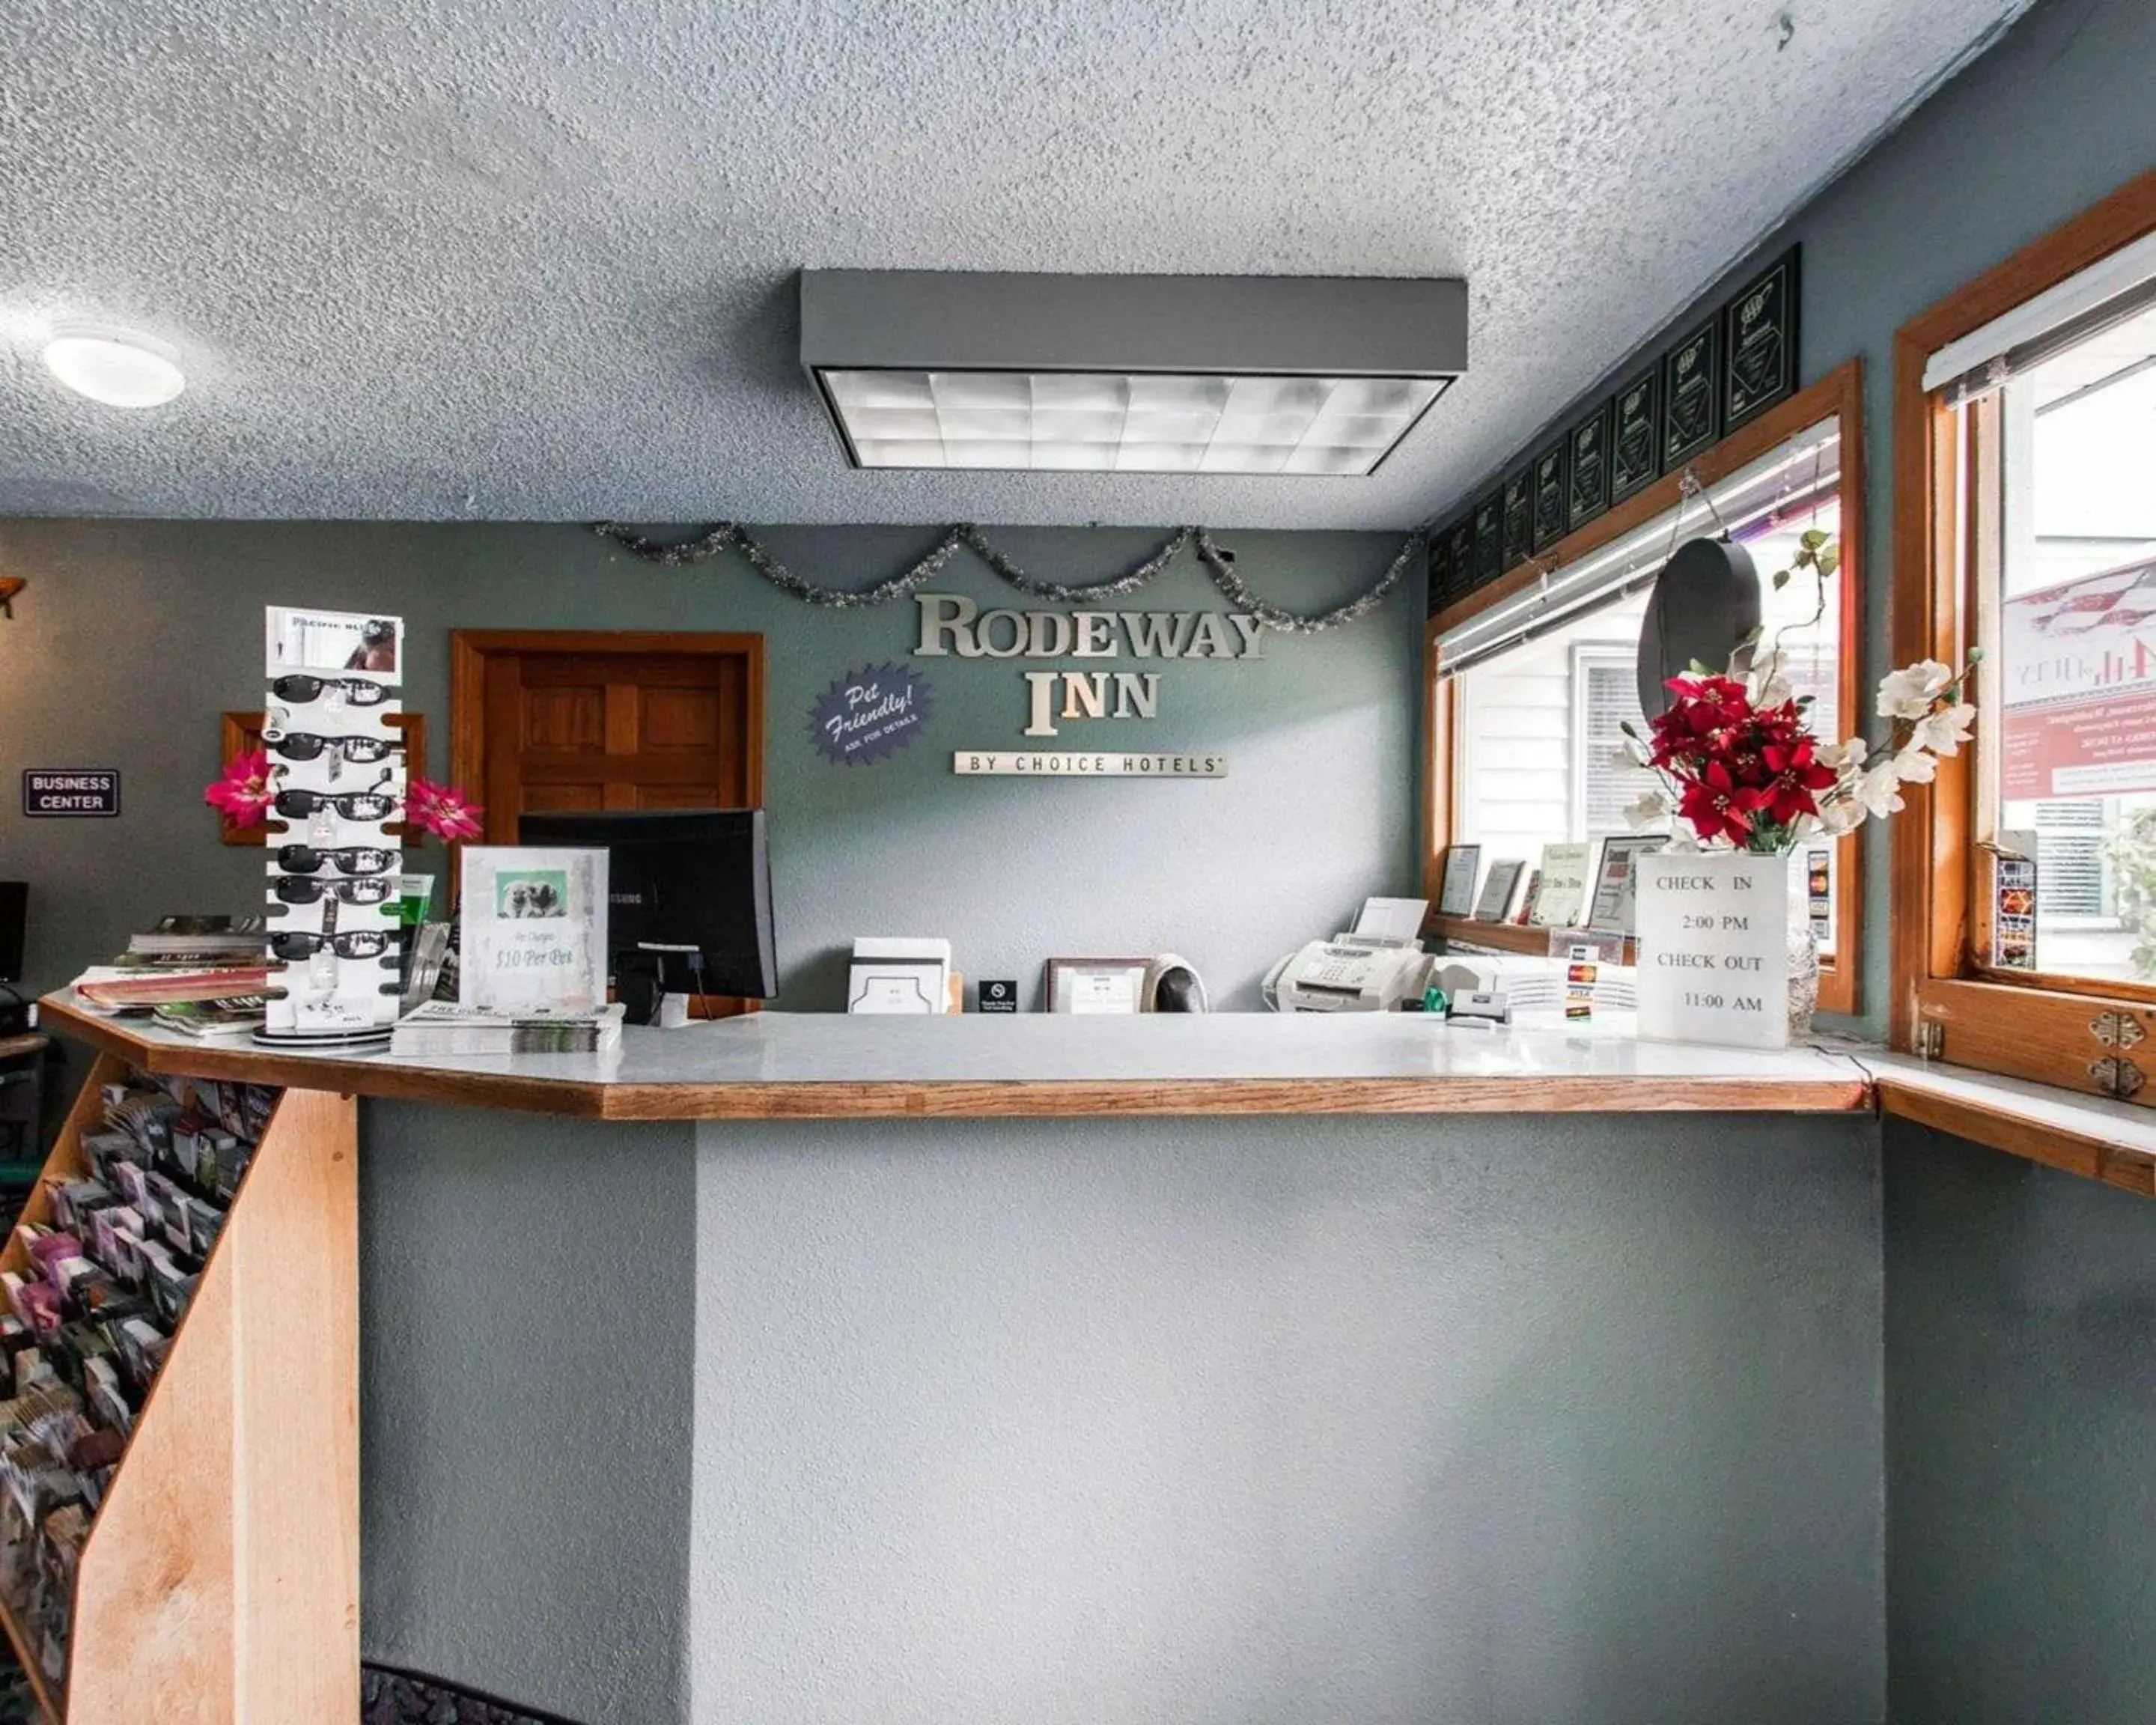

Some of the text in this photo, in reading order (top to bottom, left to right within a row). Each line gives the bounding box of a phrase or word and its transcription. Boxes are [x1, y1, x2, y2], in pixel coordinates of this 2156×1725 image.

[913, 593, 1264, 658] RODEWAY
[844, 682, 880, 711] Pet
[1023, 672, 1161, 736] INN
[825, 684, 913, 743] Friendly!
[863, 729, 882, 743] FOR
[970, 756, 996, 771] BY
[1015, 756, 1105, 772] CHOICE
[32, 776, 110, 791] BUSINESS
[40, 795, 103, 809] CENTER
[1657, 876, 1752, 890] CHECK IN
[1681, 915, 1749, 931] 2:00 PM
[524, 949, 546, 967] Per
[1657, 952, 1763, 971] CHECK OUT
[1684, 992, 1762, 1012] 11:00 AM
